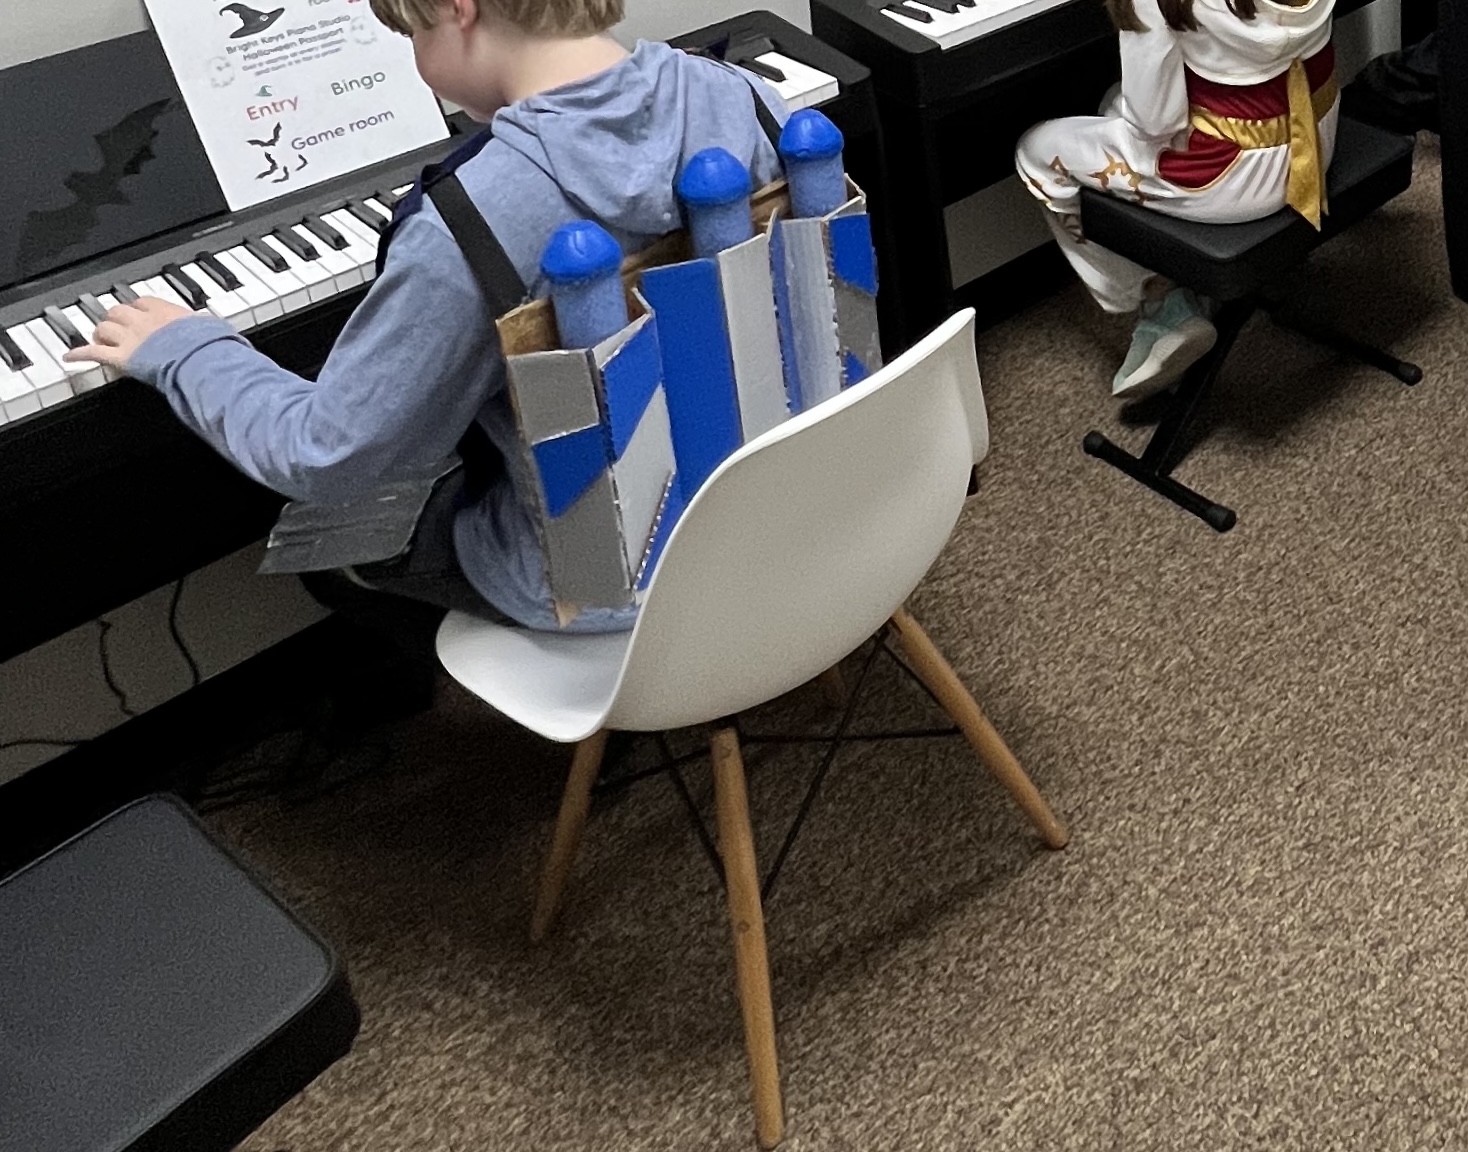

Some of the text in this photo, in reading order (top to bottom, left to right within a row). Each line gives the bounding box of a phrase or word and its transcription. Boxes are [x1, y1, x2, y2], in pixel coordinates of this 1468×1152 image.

[226, 15, 351, 54] Bright Keys Piano Studio
[242, 27, 344, 61] Halloween Passport
[331, 71, 386, 96] Bingo
[246, 96, 299, 121] Entry
[291, 110, 395, 151] Game room
